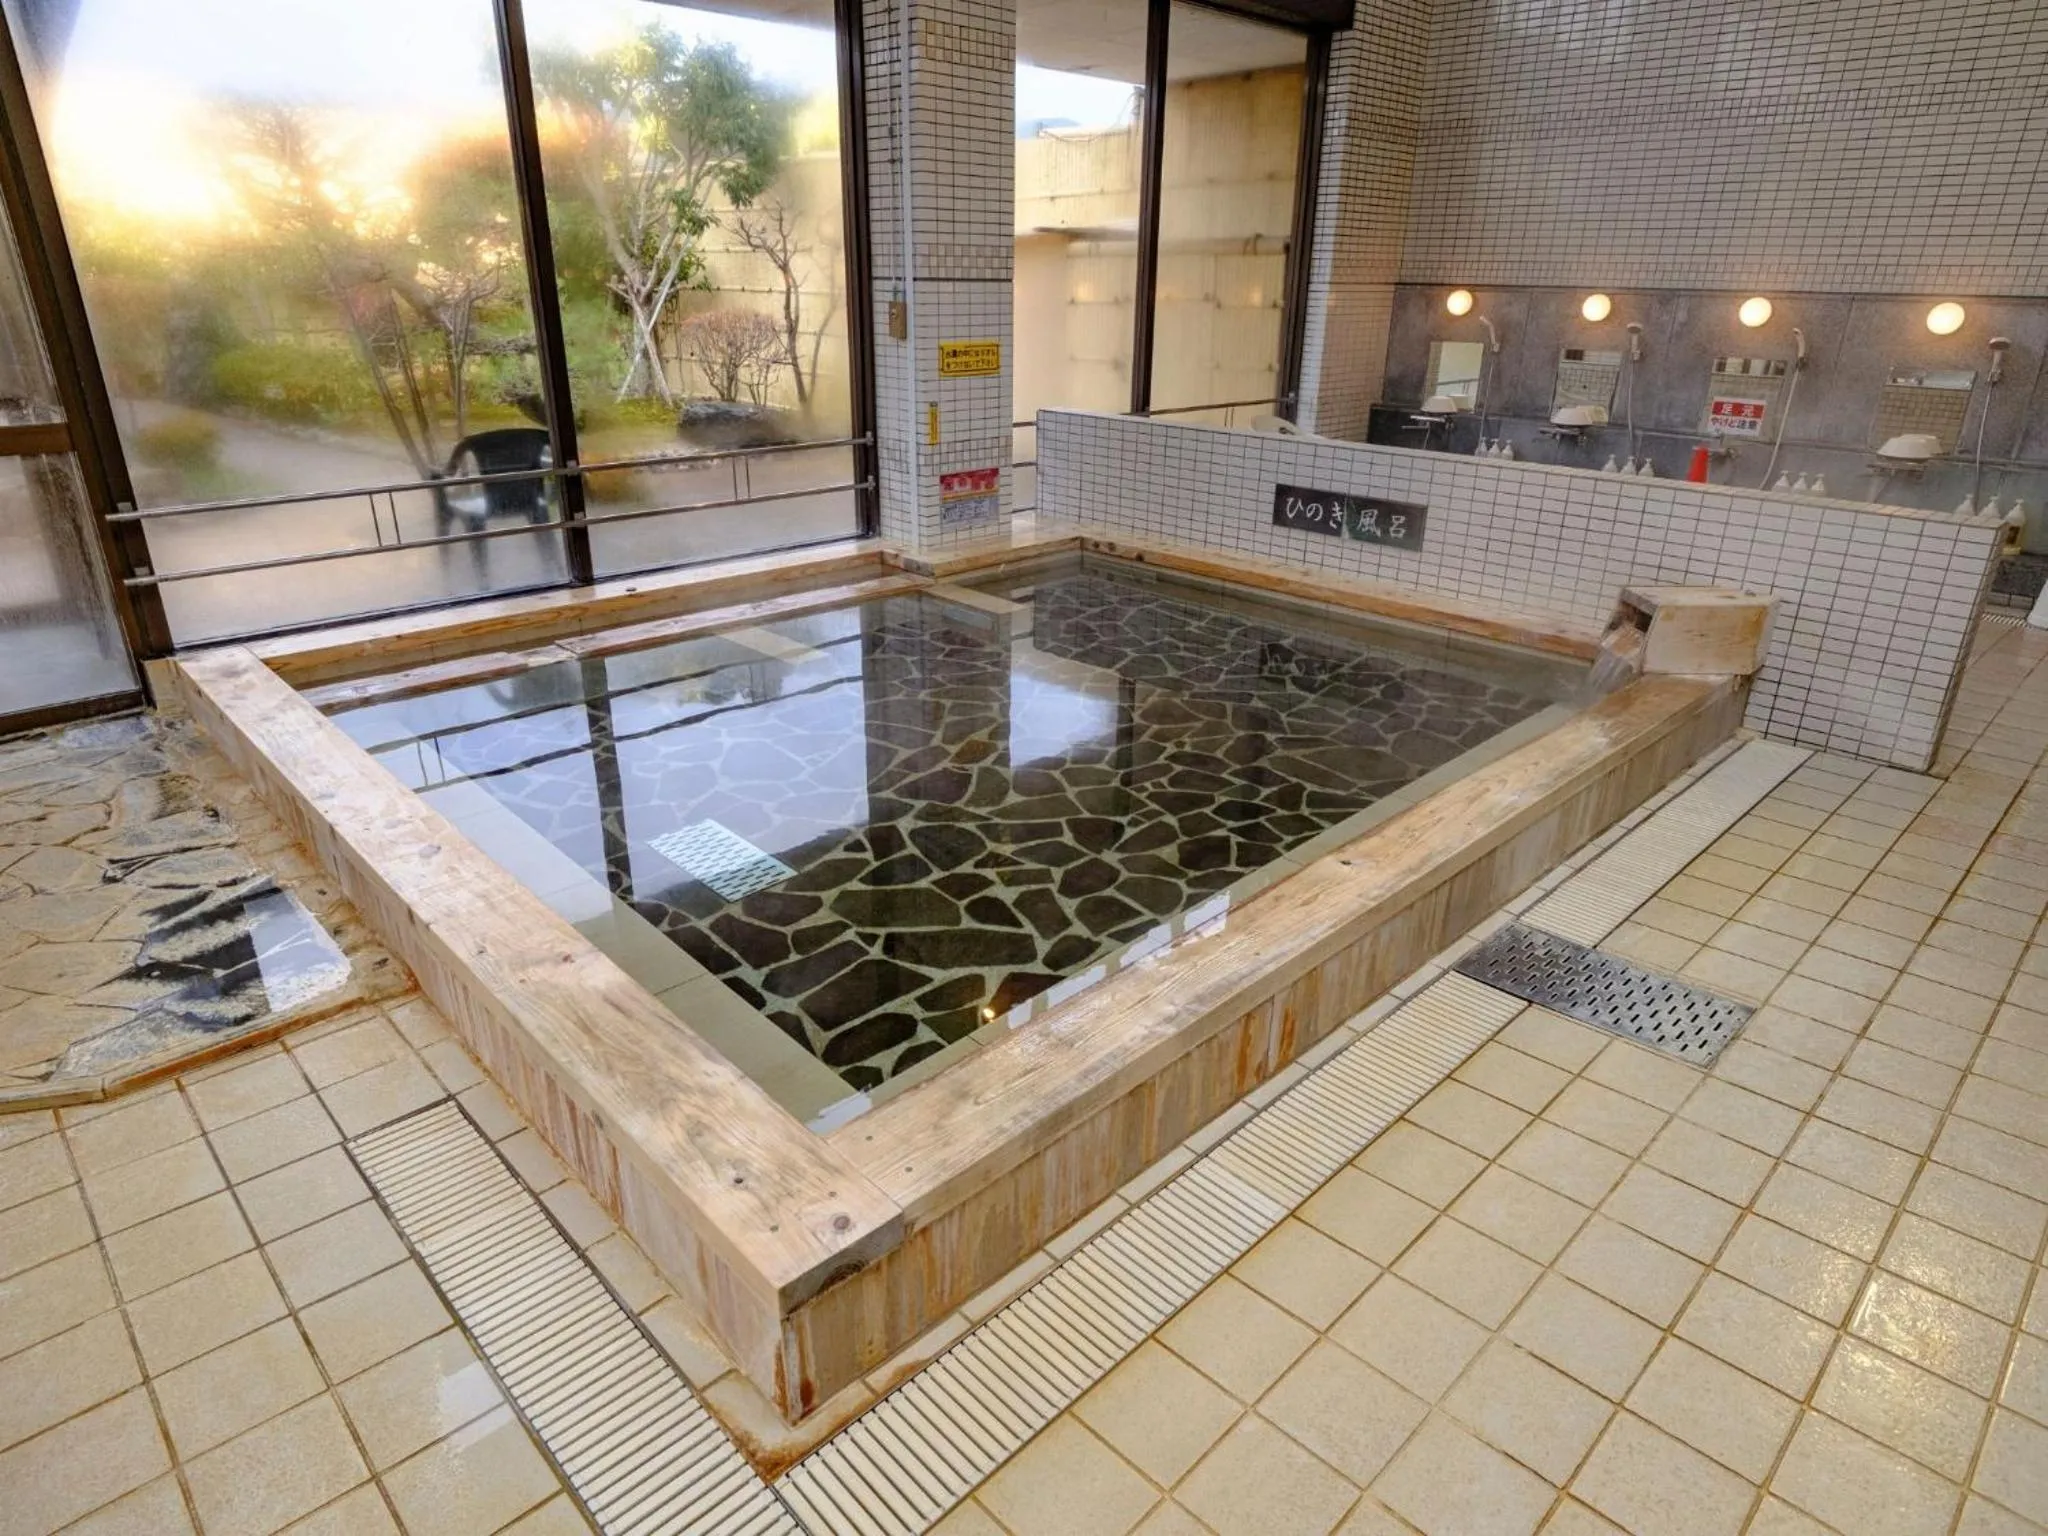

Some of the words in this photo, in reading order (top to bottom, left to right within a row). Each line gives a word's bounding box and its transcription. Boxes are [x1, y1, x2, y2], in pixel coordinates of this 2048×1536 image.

[1285, 496, 1408, 539] ひのき風呂
